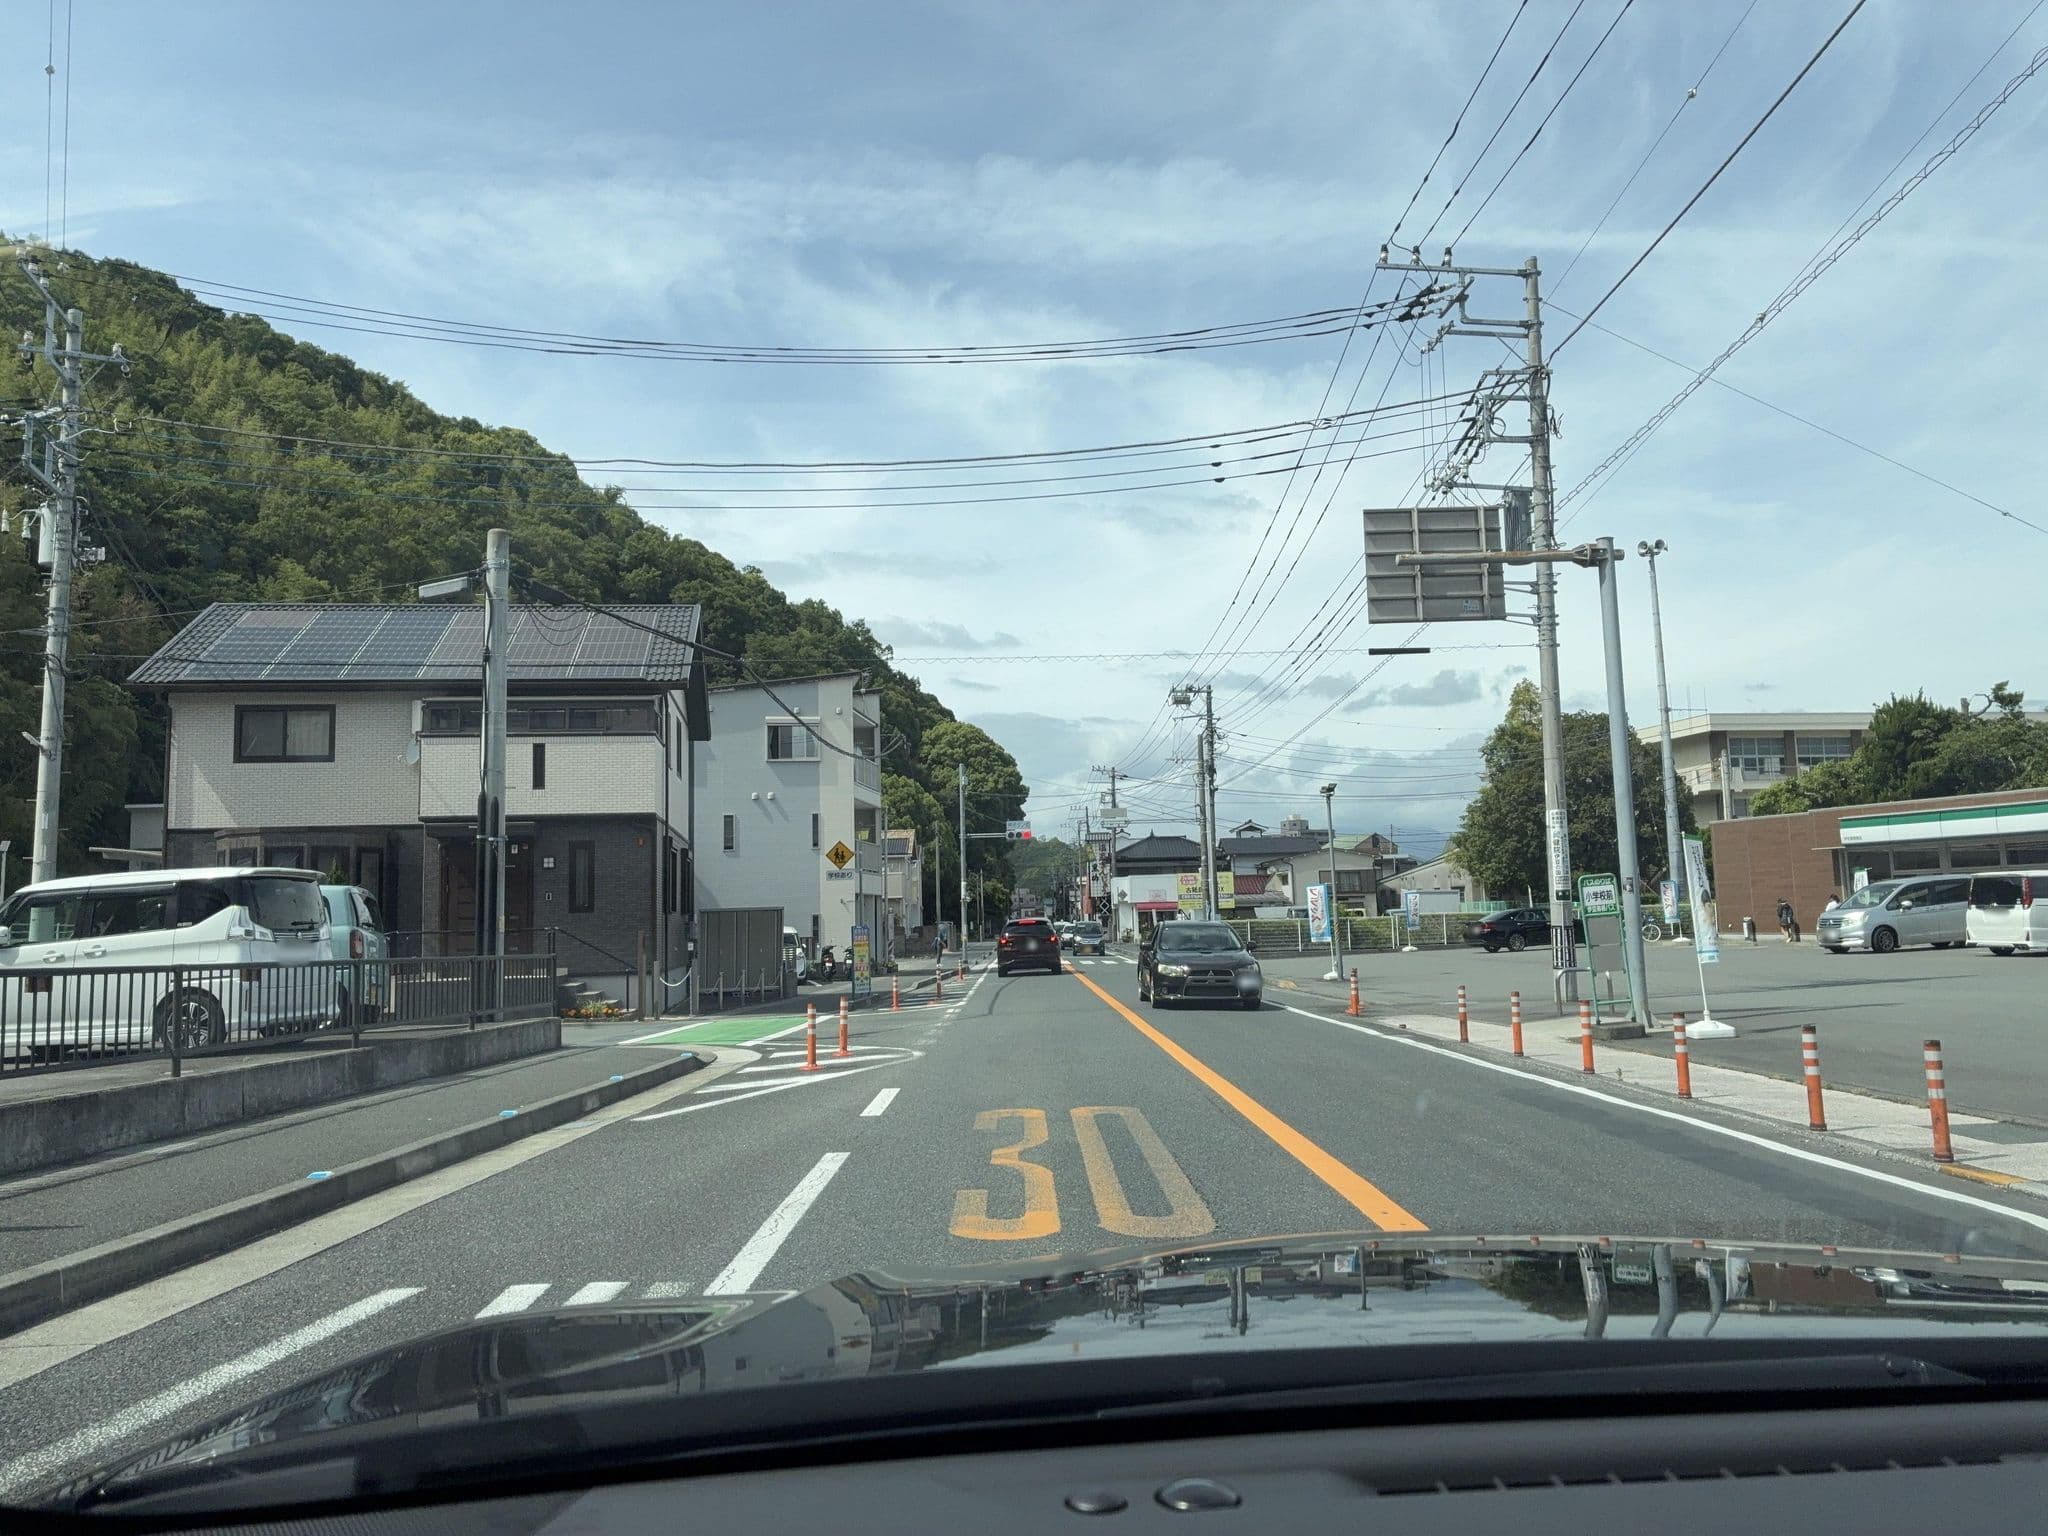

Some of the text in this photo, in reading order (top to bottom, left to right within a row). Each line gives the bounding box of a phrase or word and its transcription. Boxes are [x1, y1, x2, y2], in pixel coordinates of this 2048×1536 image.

[1583, 878, 1611, 886] バスのりば
[1585, 889, 1614, 902] 小学校前
[949, 1106, 1217, 1240] 30
